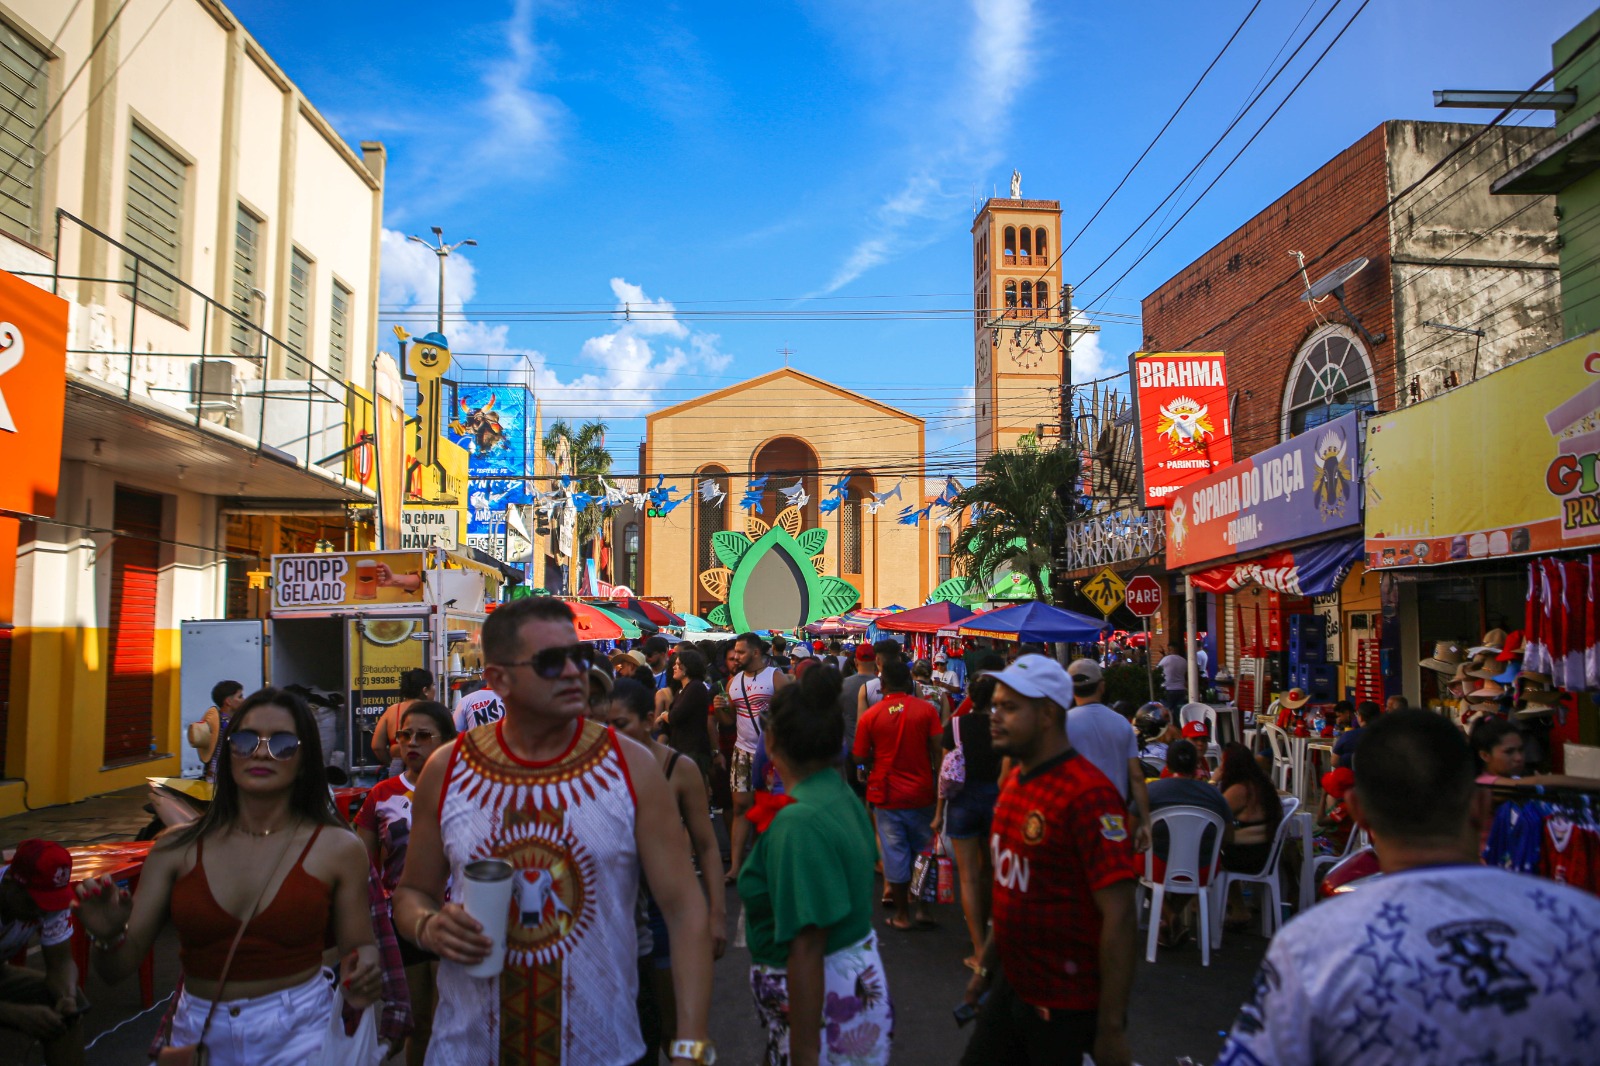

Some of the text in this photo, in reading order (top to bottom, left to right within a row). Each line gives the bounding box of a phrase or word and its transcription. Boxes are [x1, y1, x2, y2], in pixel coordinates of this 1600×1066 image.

[1138, 361, 1224, 388] BRAHMA
[1166, 459, 1211, 469] PARINTINS
[1546, 453, 1600, 496] GI
[1192, 448, 1305, 526] SOPARIA DO KBÇA
[414, 511, 445, 525] CÓPIA
[1564, 495, 1600, 530] PR
[1228, 514, 1258, 546] BRAHMA
[401, 534, 437, 549] HAVE
[282, 560, 343, 582] CHOPP
[282, 582, 342, 602] GELADO
[1128, 588, 1159, 604] PARE
[355, 706, 384, 715] CHOPP
[471, 700, 490, 711] TEAM
